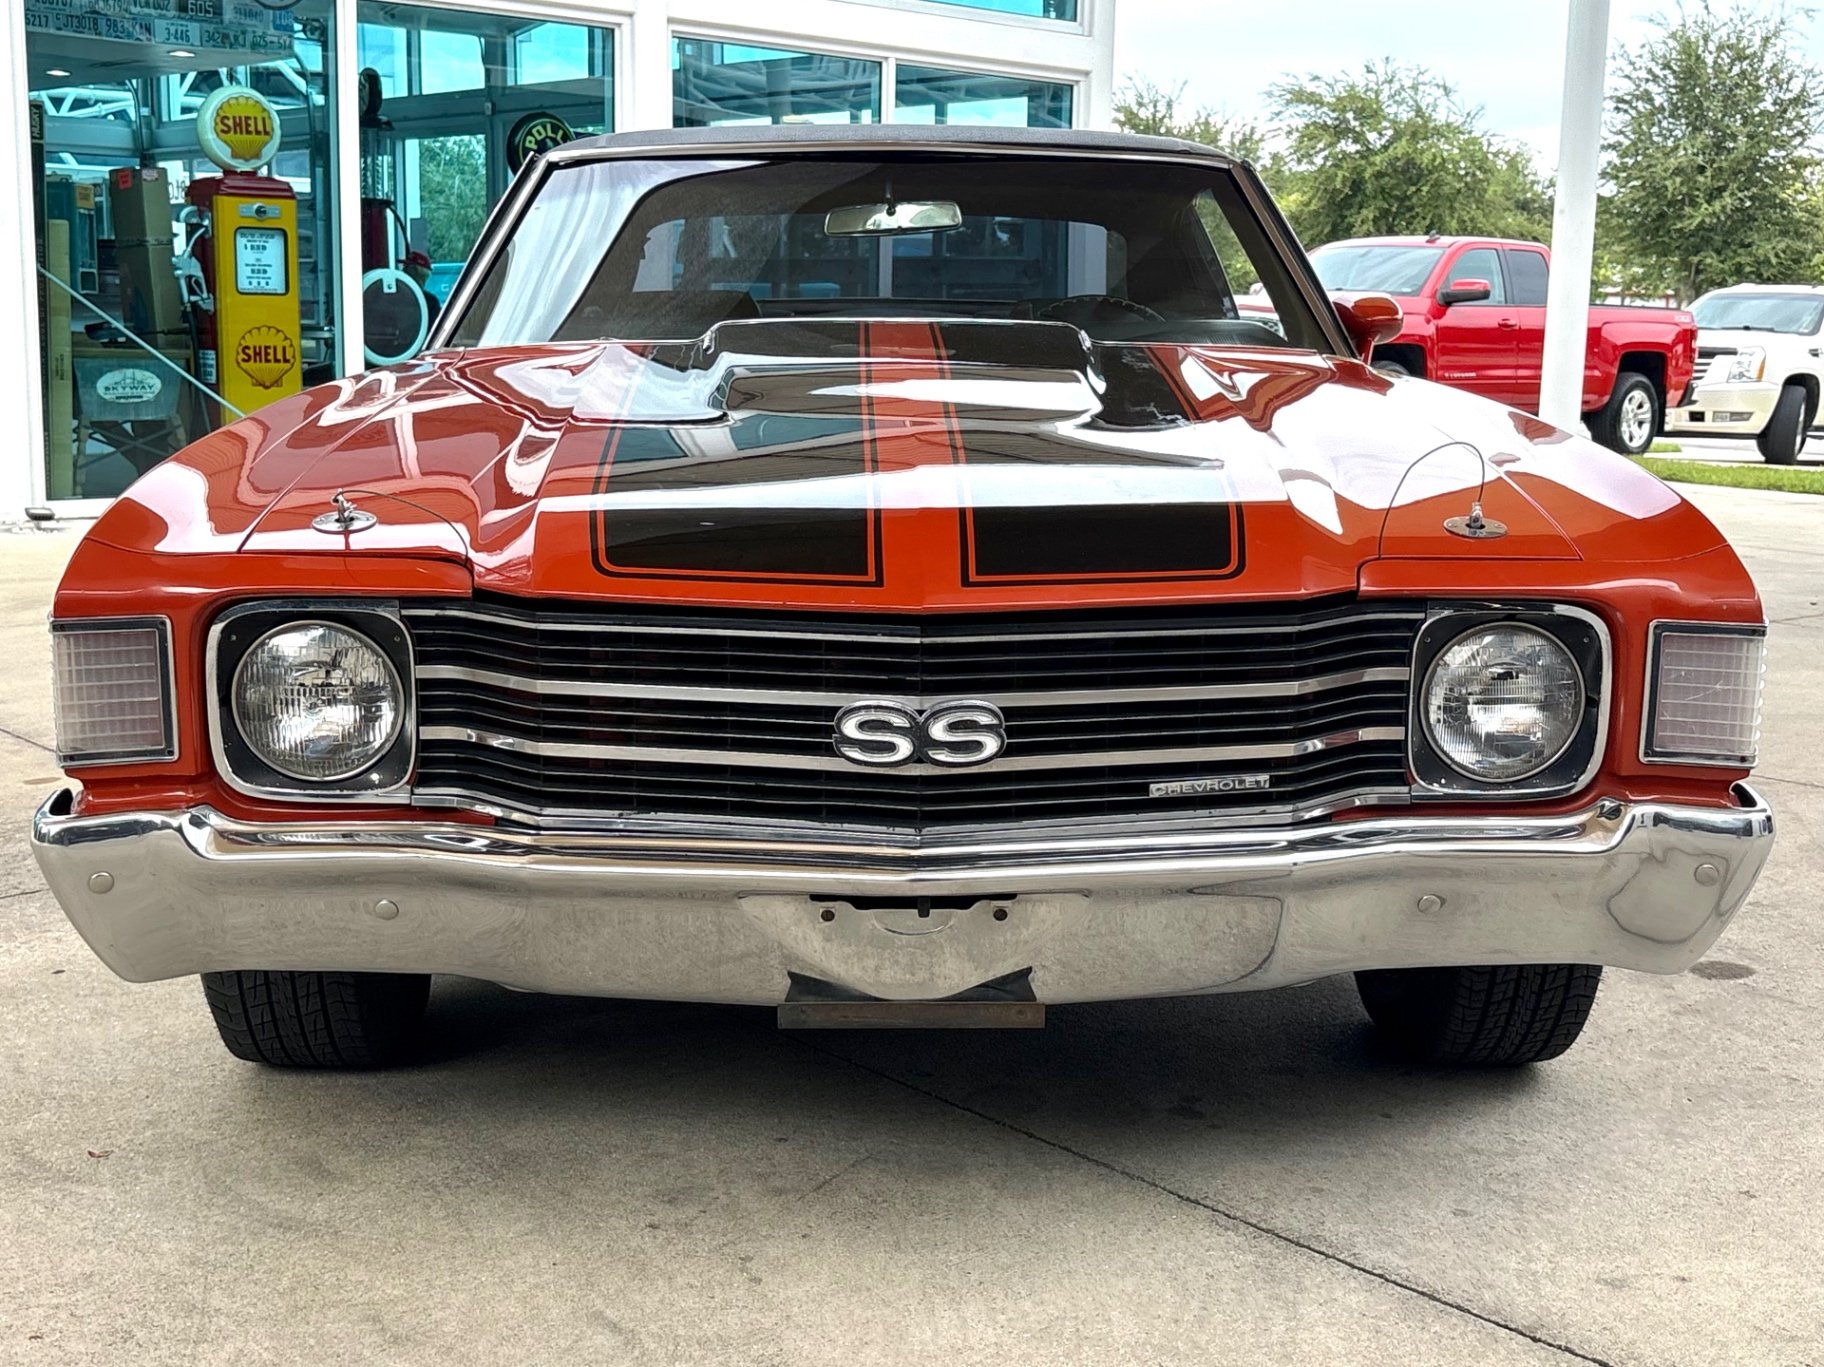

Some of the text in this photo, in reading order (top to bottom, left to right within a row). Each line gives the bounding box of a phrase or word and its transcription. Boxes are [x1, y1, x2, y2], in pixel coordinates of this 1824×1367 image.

[188, 0, 213, 17] 605
[220, 115, 271, 136] SHELL
[525, 123, 566, 150] POLL
[241, 345, 291, 364] SHELL
[104, 384, 155, 392] SKYWAY
[836, 704, 1004, 766] SS
[1150, 775, 1270, 797] CHEVROLET
